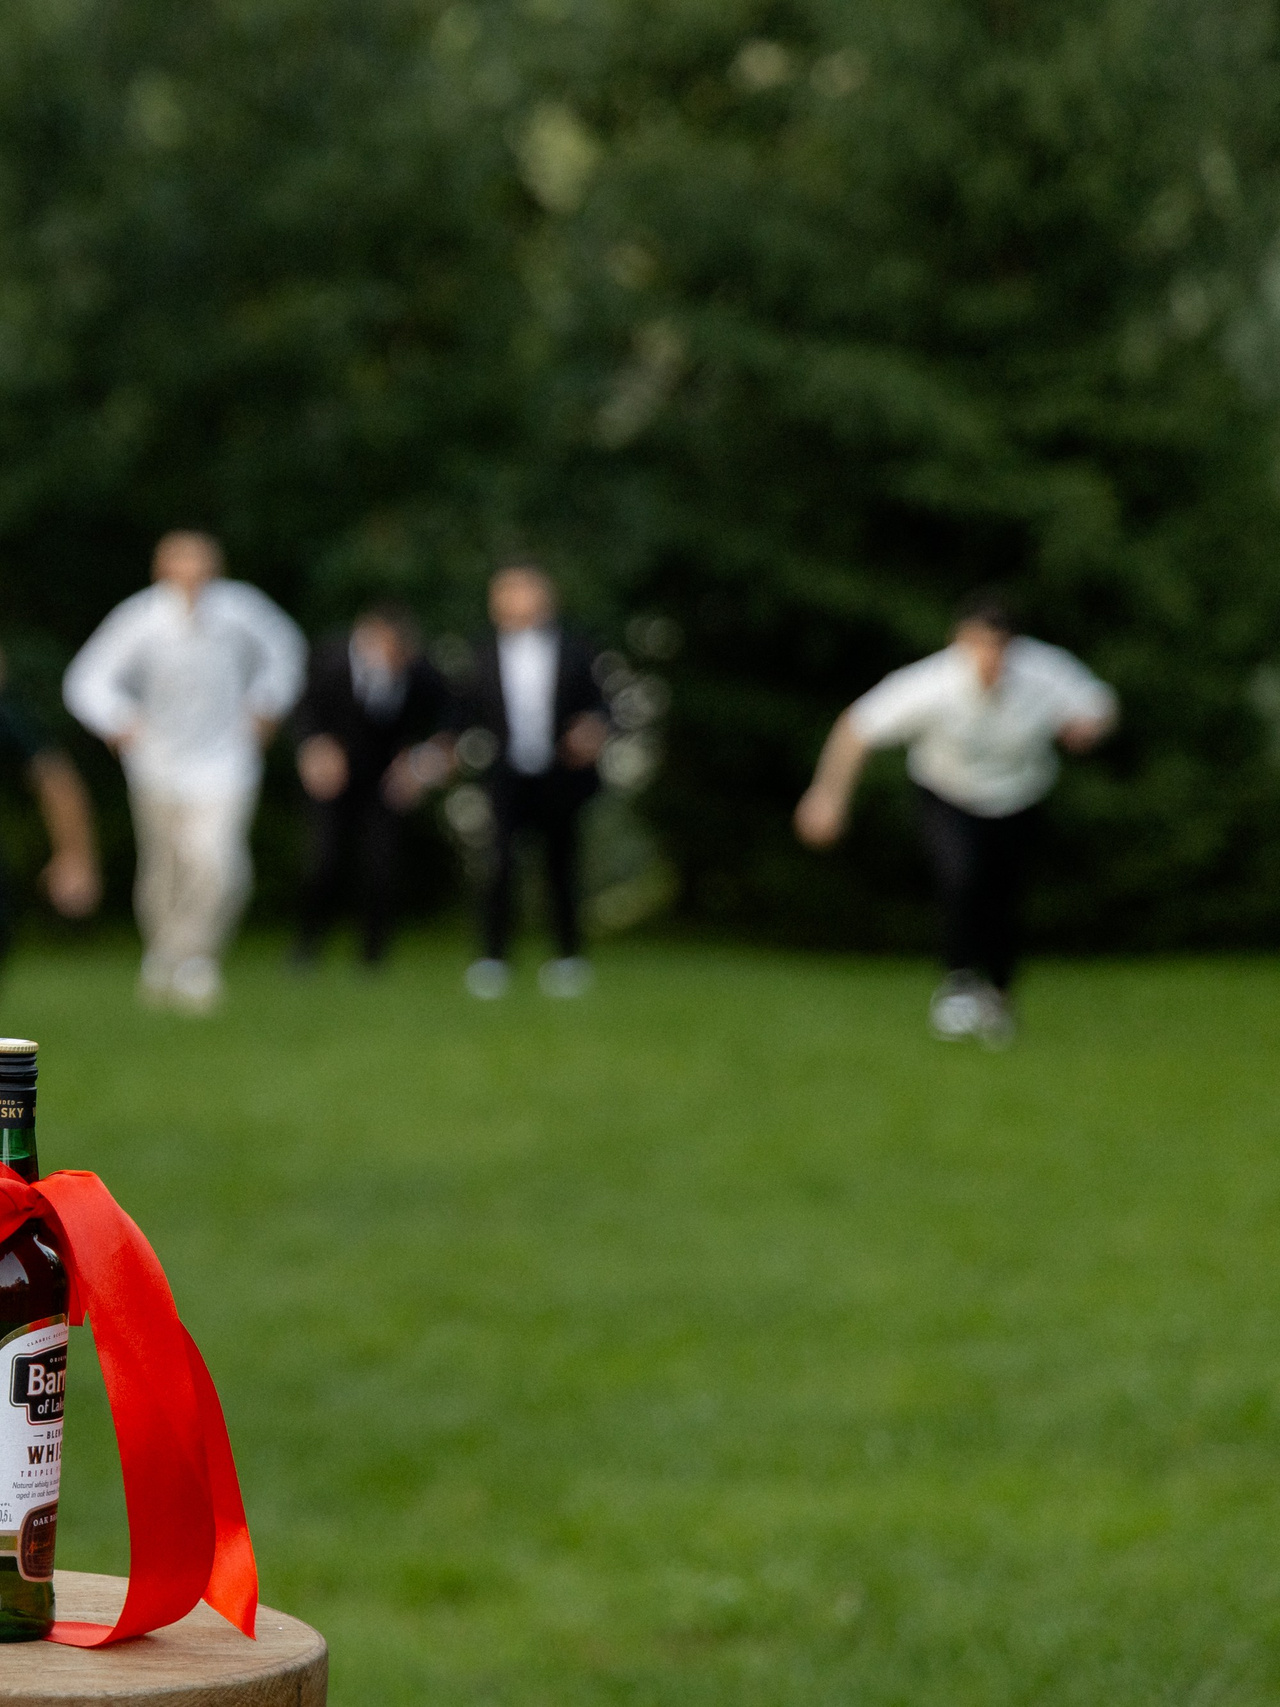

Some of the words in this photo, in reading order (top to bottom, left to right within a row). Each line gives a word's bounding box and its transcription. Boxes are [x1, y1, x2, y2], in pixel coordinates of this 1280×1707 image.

[26, 1335, 51, 1347] CLASSIC
[37, 1398, 50, 1414] of
[20, 1468, 53, 1477] TRIPLE
[12, 1481, 34, 1489] Natural
[16, 1490, 30, 1500] aged
[32, 1516, 49, 1527] OAK
